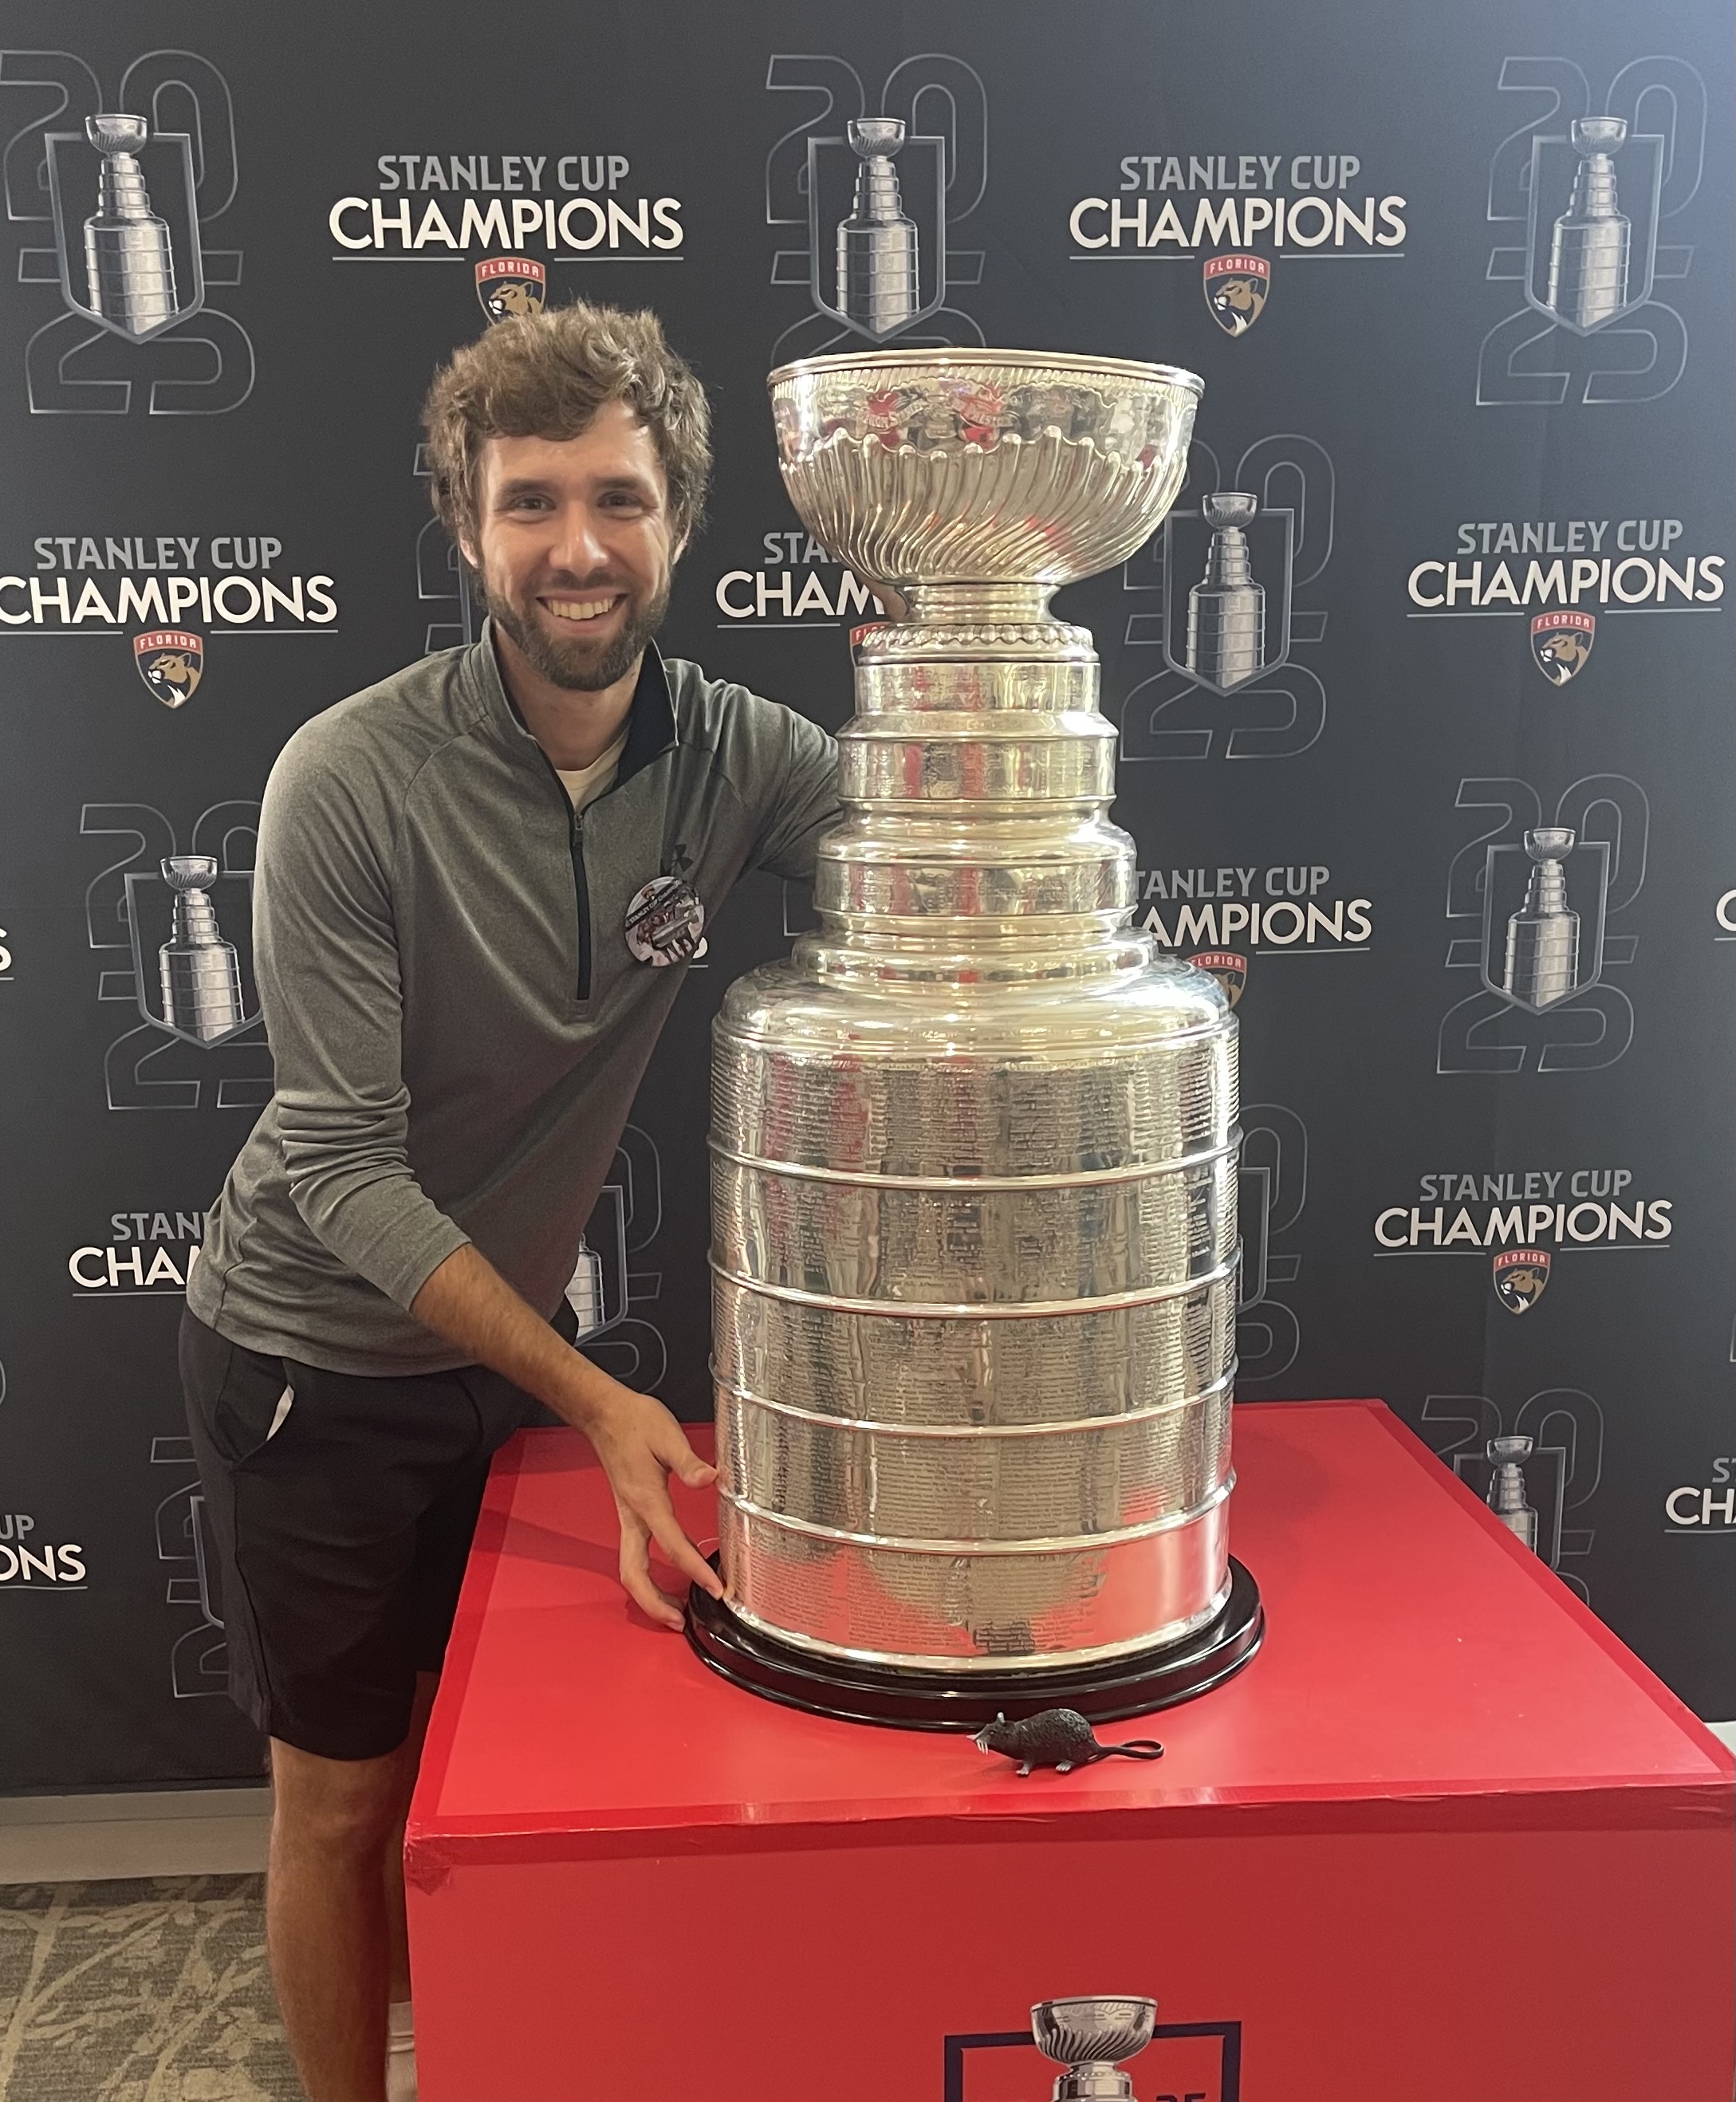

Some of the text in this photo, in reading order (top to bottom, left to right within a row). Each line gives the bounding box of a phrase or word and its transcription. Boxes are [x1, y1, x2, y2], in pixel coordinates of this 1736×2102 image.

[378, 155, 630, 191] STANLEY CUP
[1120, 155, 1360, 191] STANLEY CUP
[329, 197, 683, 250] CHAMPIONS
[1069, 196, 1407, 249] CHAMPIONS
[482, 261, 539, 277] FLORIDA
[1210, 258, 1265, 274] FLORIDA
[34, 537, 282, 570] STANLEY CUP
[1457, 519, 1683, 554] STANLEY CUP
[1407, 556, 1726, 607] CHAMPIONS
[0, 575, 337, 624] CHAMPIONS
[1537, 614, 1590, 628] FLORIDA
[140, 634, 196, 649] FLORIDA
[1136, 868, 1257, 900] ANLEY
[1266, 866, 1330, 896] CUP
[1140, 899, 1372, 947] AMPIONS
[1420, 1169, 1632, 1202] STANLEY CUP
[111, 1212, 207, 1242] STAN
[1374, 1199, 1673, 1247] CHAMPIONS
[1498, 1251, 1545, 1266] FLORIDA
[0, 1514, 34, 1541] UP
